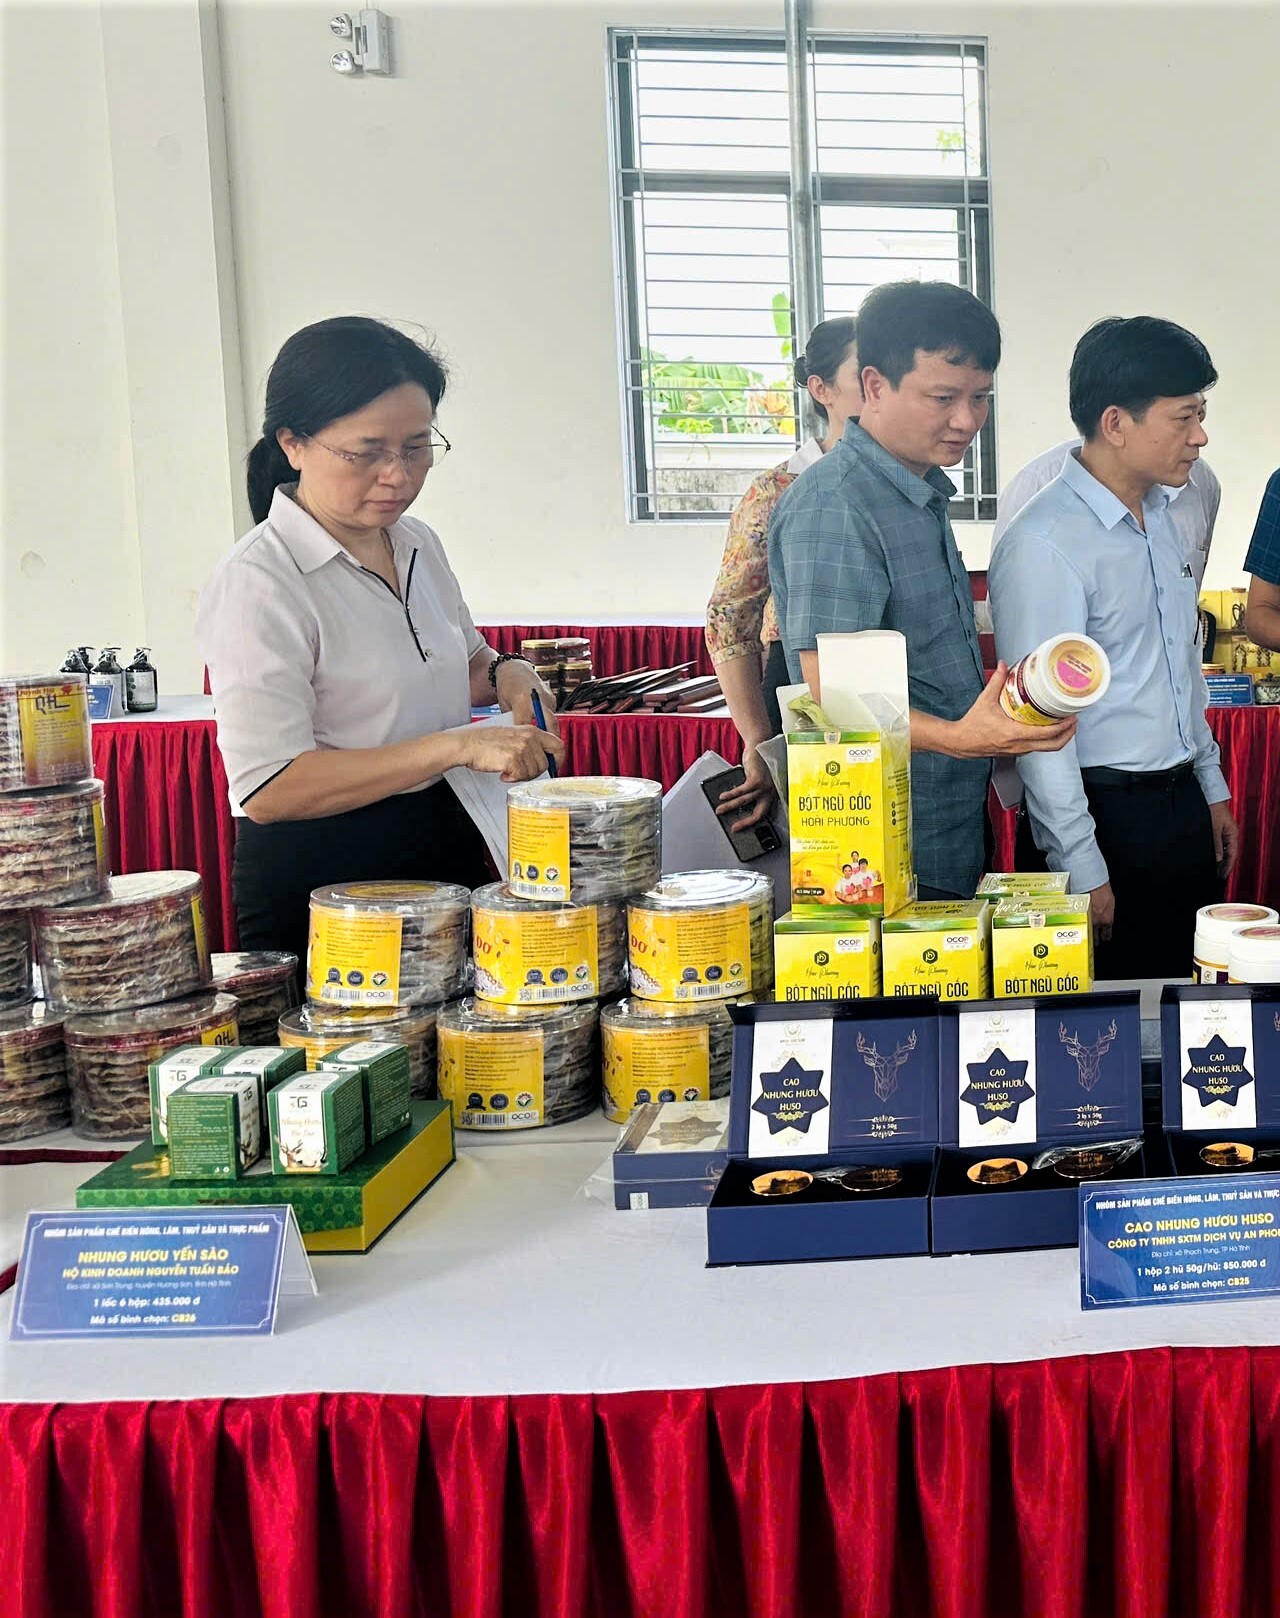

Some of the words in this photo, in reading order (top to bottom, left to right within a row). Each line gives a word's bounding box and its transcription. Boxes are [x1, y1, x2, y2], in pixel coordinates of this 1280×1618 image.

[799, 794, 821, 812] BỘT
[823, 794, 845, 811] NGŨ
[849, 791, 871, 811] CỐC
[827, 815, 870, 827] PHƯƠNG
[946, 978, 969, 998] CỐC
[1005, 976, 1030, 995] BỘT
[1030, 976, 1052, 994] NGŨ
[1056, 973, 1079, 992] CỐC
[1209, 1053, 1225, 1062] CAO
[989, 1068, 1006, 1077] CAO
[1192, 1065, 1221, 1074] NHUNG
[1221, 1063, 1244, 1073] HƯƠU
[783, 1078, 800, 1087] CAO
[971, 1080, 1001, 1090] NHUNG
[1002, 1078, 1025, 1089] HƯƠU
[1208, 1076, 1229, 1086] HUSO
[763, 1090, 794, 1100] NHUNG
[795, 1088, 820, 1099] HƯƠU
[987, 1092, 1009, 1102] HUSO
[779, 1102, 802, 1111] HUSO
[1124, 1221, 1153, 1233] CAO
[1156, 1218, 1200, 1231] NHUNG
[1203, 1214, 1238, 1228] HƯƠU
[1241, 1212, 1274, 1225] HUSO
[1107, 1238, 1137, 1249] CÔNG
[1138, 1237, 1149, 1246] TY
[1151, 1236, 1176, 1246] TNHH
[1177, 1234, 1201, 1244] SXTM
[1203, 1232, 1226, 1243] DỊCH
[1229, 1231, 1241, 1242] VỤ
[1243, 1230, 1257, 1240] AN
[78, 1250, 127, 1263] NHUNG
[130, 1249, 169, 1262] HƯƠU
[173, 1245, 197, 1261] YẾN
[200, 1246, 229, 1260] SÀO
[62, 1266, 80, 1280] HỘ
[81, 1267, 105, 1278] KINH
[107, 1266, 144, 1277] DOANH
[145, 1263, 187, 1276] NGUYỄN
[1137, 1268, 1142, 1276] 1
[1145, 1267, 1162, 1278] hộp
[1164, 1267, 1171, 1275] 2
[1172, 1264, 1184, 1274] hũ
[1186, 1261, 1221, 1274] 50g/hũ:
[1223, 1259, 1258, 1270] 850.000
[1260, 1258, 1266, 1267] đ
[1153, 1282, 1167, 1292] Mã
[1169, 1280, 1181, 1290] số
[1181, 1280, 1200, 1290] bình
[1201, 1279, 1225, 1289] chọn:
[1227, 1277, 1250, 1286] CB25
[93, 1299, 98, 1307] 1
[119, 1298, 126, 1306] 6
[128, 1297, 150, 1309] hộp:
[193, 1296, 200, 1305] đ
[107, 1314, 120, 1324] số
[120, 1314, 141, 1323] bình
